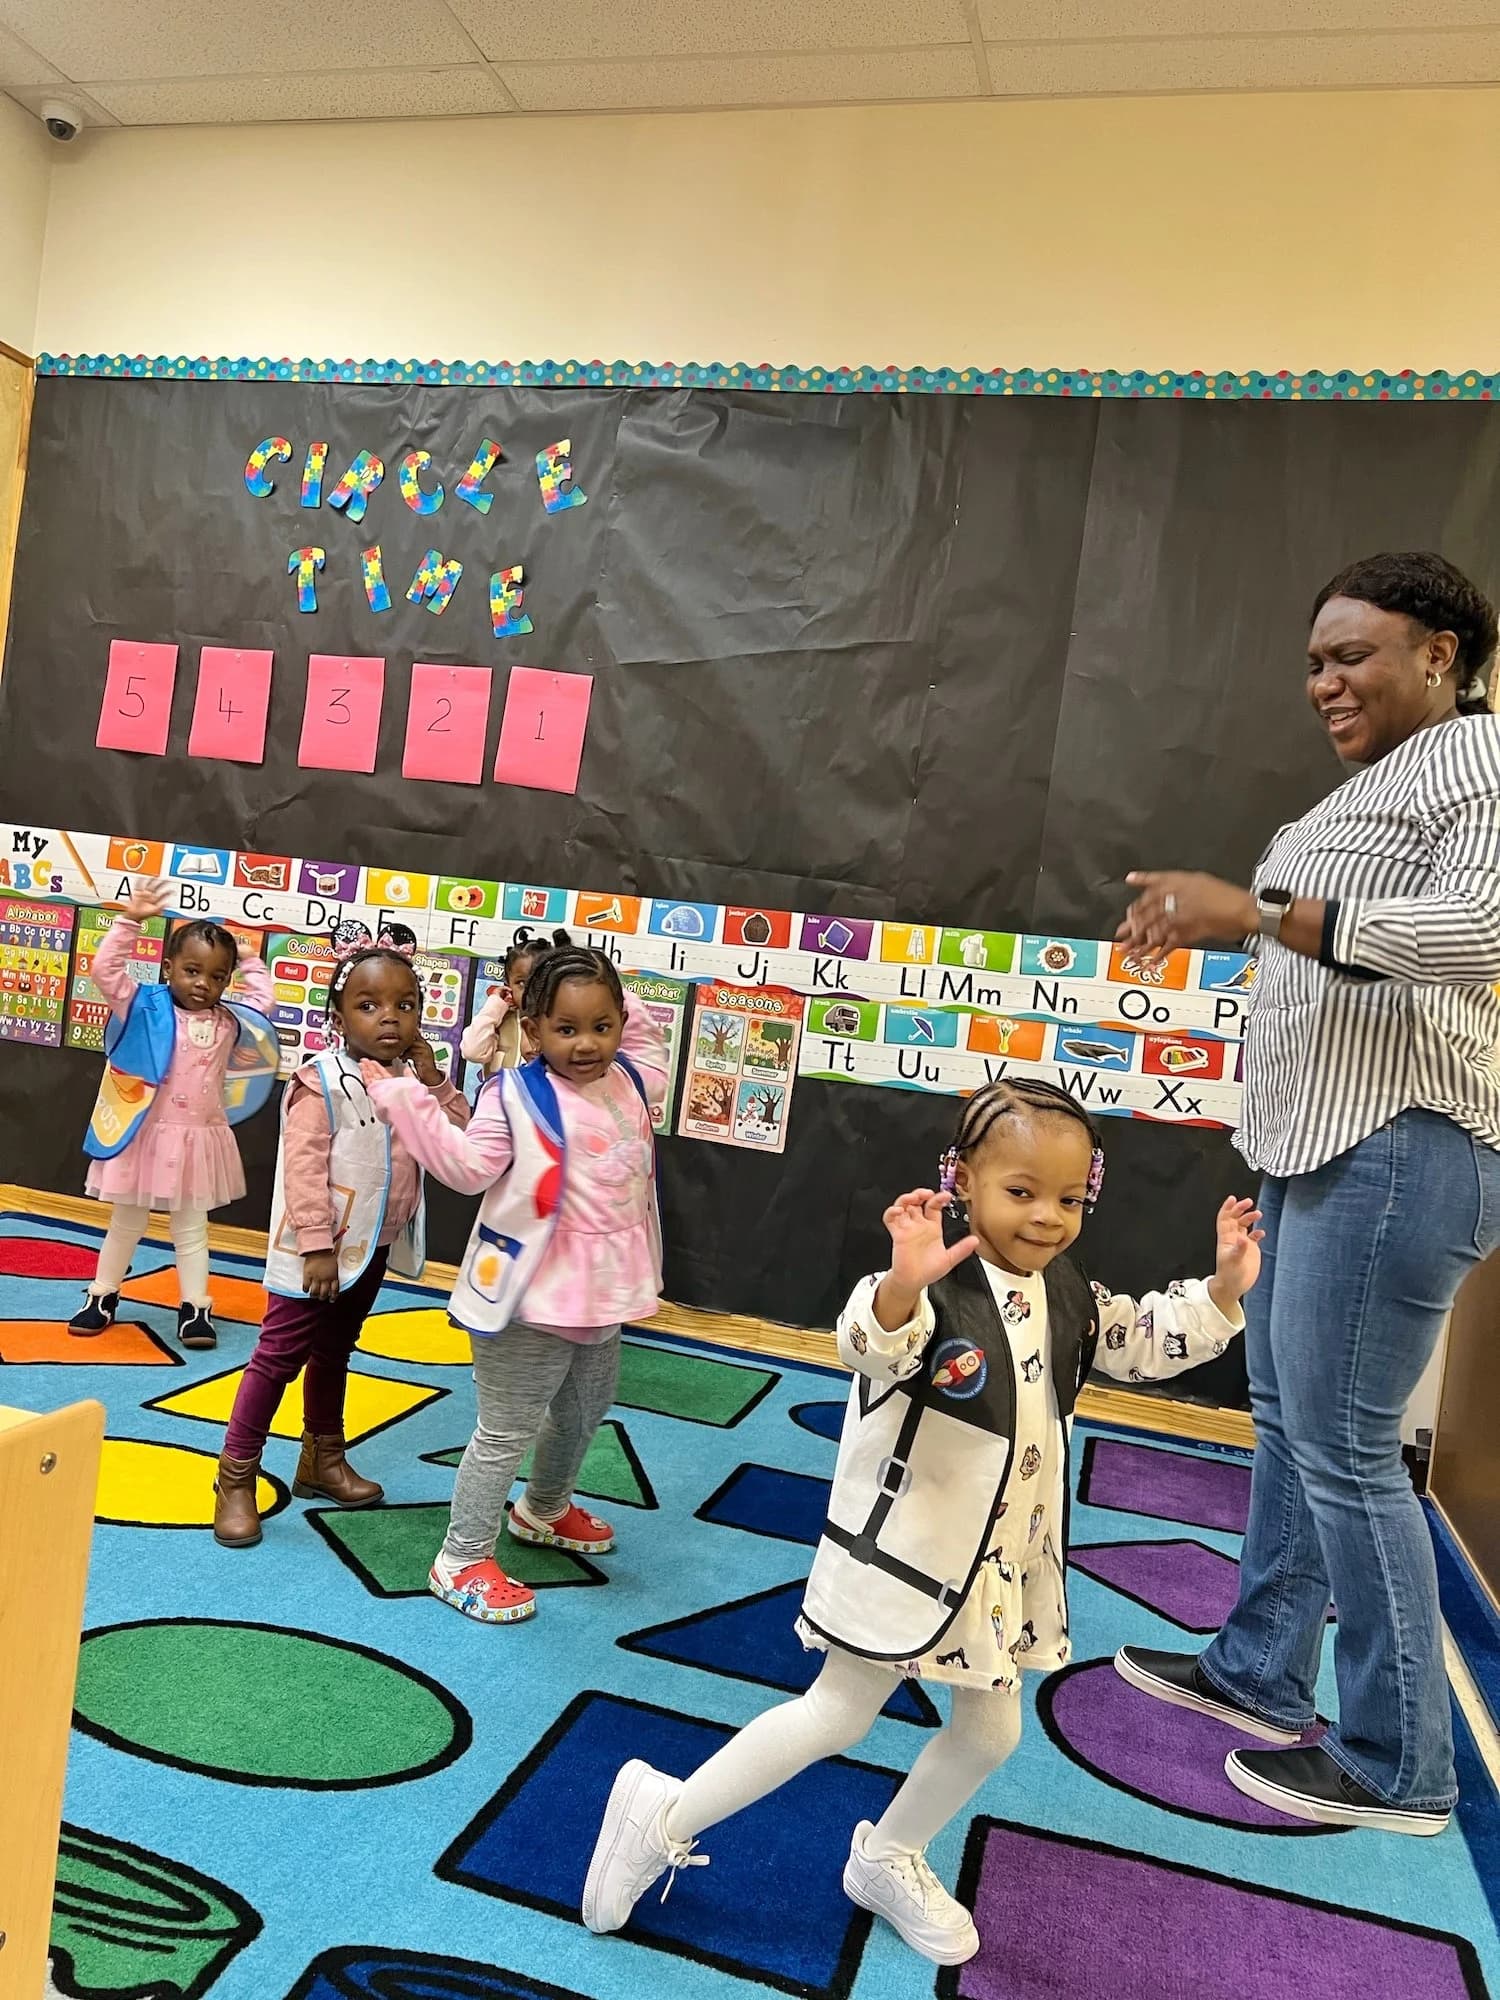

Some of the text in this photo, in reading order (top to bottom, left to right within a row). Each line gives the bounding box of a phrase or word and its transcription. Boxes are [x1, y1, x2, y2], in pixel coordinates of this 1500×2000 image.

[244, 436, 588, 522] CIRCLE
[287, 545, 534, 639] TIME
[118, 675, 146, 718] 5
[217, 686, 244, 723] 4
[325, 688, 351, 725] 3
[426, 698, 452, 733] 2
[533, 709, 546, 741] 1
[12, 831, 49, 859] My
[0, 858, 63, 893] ABCs
[7, 906, 58, 923] Alphabet
[9, 924, 21, 933] Bb
[24, 926, 36, 936] Cc
[39, 928, 51, 938] Dd
[54, 930, 66, 940] Ee
[114, 876, 134, 901] A
[179, 883, 210, 912] Bb
[243, 892, 274, 921] Cc
[305, 900, 342, 928] Dd
[449, 918, 479, 947] Ff
[670, 942, 686, 971] Ii
[737, 951, 769, 986] Jj
[812, 958, 849, 990] Kk
[899, 967, 926, 998] Ll
[939, 971, 1001, 1006] Mm
[1032, 979, 1079, 1014] Nn
[1118, 989, 1170, 1023] Oo
[288, 939, 338, 957] Color
[80, 956, 88, 971] 3
[415, 955, 449, 969] Shapes
[1207, 954, 1231, 962] parrot
[2, 969, 16, 980] Mm
[34, 974, 47, 984] Oo
[50, 976, 61, 987] Pp
[284, 966, 298, 976] Red
[76, 980, 86, 993] 5
[640, 984, 656, 997] the
[656, 984, 679, 999] Year
[2, 992, 13, 1002] Rr
[32, 996, 42, 1007] Tt
[46, 998, 58, 1009] Uu
[717, 989, 784, 1013] Seasons
[75, 1003, 84, 1018] 7
[279, 1010, 295, 1019] Blue
[15, 1017, 27, 1028] Xx
[30, 1020, 41, 1032] Yy
[44, 1022, 56, 1033] Zz
[72, 1026, 82, 1040] 9
[278, 1032, 296, 1041] rown
[705, 1060, 727, 1071] Spring
[752, 1068, 779, 1078] Summer
[822, 1040, 855, 1072] Tt
[898, 1049, 940, 1082] Uu
[1059, 1068, 1122, 1105] Ww
[1153, 1079, 1203, 1115] Xx
[695, 1122, 720, 1133] Autumn
[745, 1131, 767, 1142] Winter
